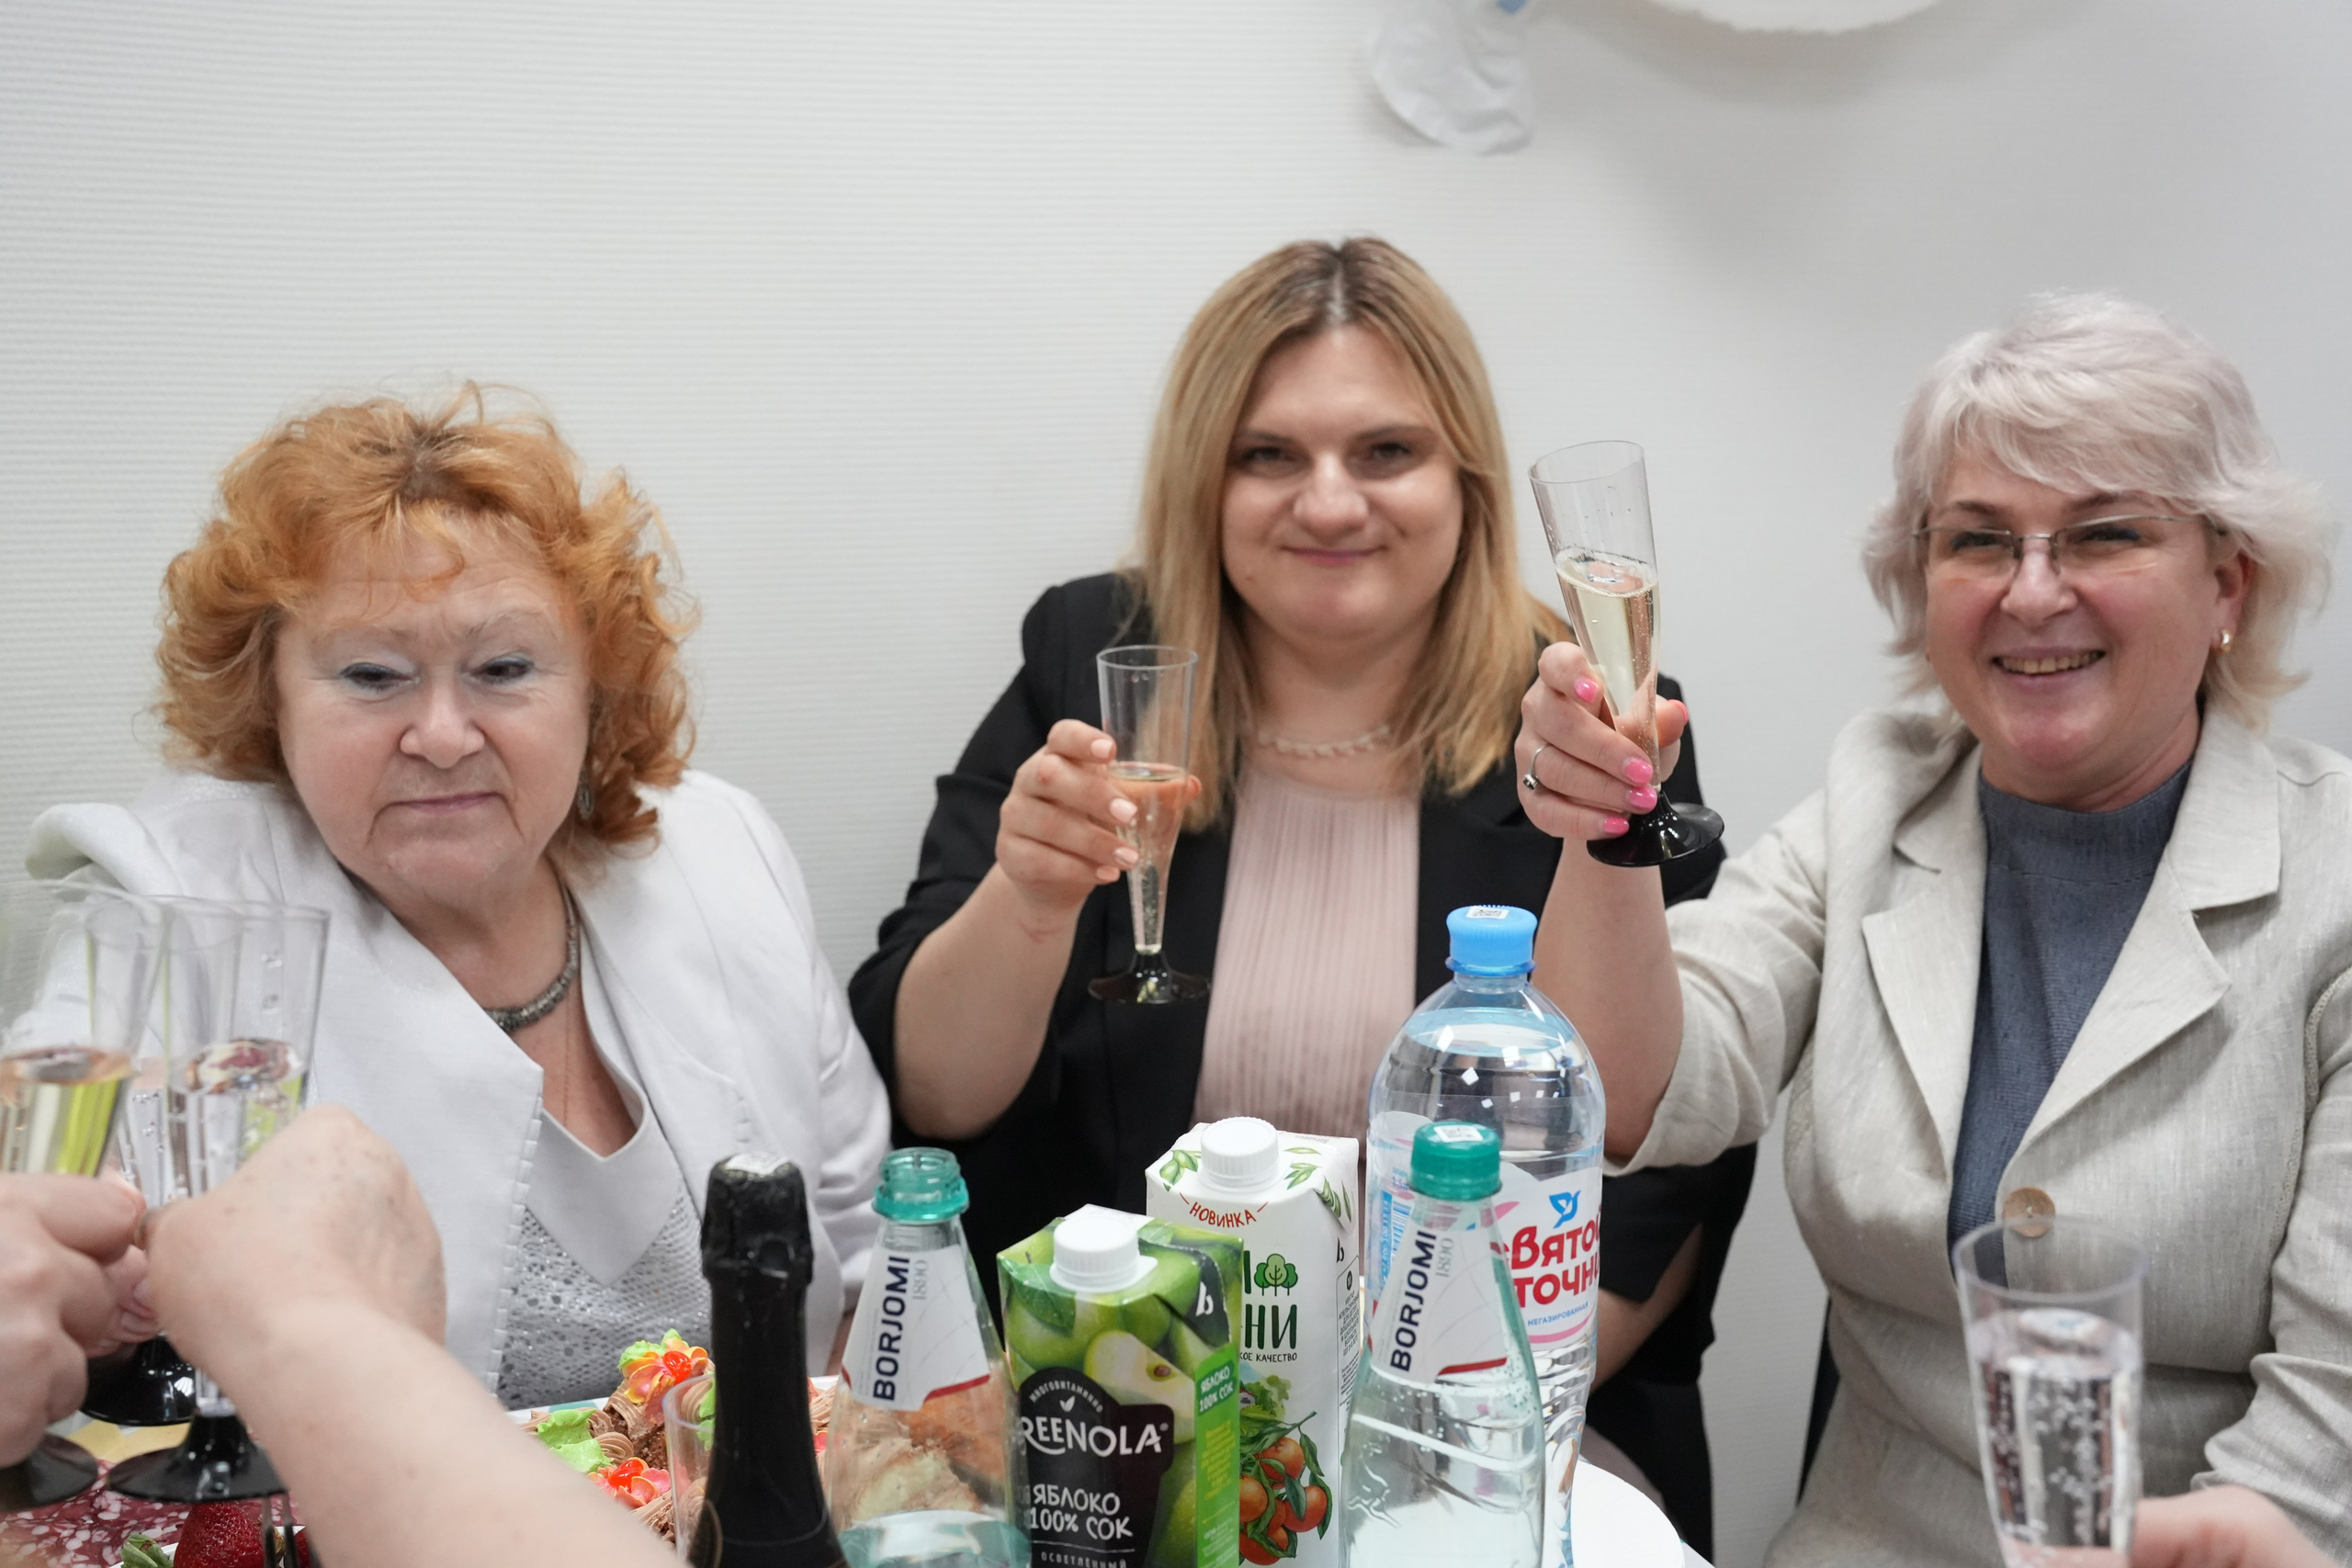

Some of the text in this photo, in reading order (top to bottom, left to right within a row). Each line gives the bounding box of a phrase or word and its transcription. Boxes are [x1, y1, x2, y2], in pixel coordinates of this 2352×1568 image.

[1190, 1202, 1256, 1228] НОВИНКА
[1435, 1237, 1454, 1278] 1890
[1513, 1251, 1599, 1308] ТОЧН
[1390, 1230, 1437, 1371] BORJOMI
[1528, 1301, 1589, 1326] НЕГАЗИРОВАННАЯ
[873, 1256, 910, 1401] BORJOMI
[1256, 1352, 1297, 1363] КАЧЕСТВО
[1021, 1416, 1162, 1457] REENOLA
[1033, 1483, 1120, 1516] ЯБЛОКО
[1030, 1506, 1133, 1540] 100% СОК
